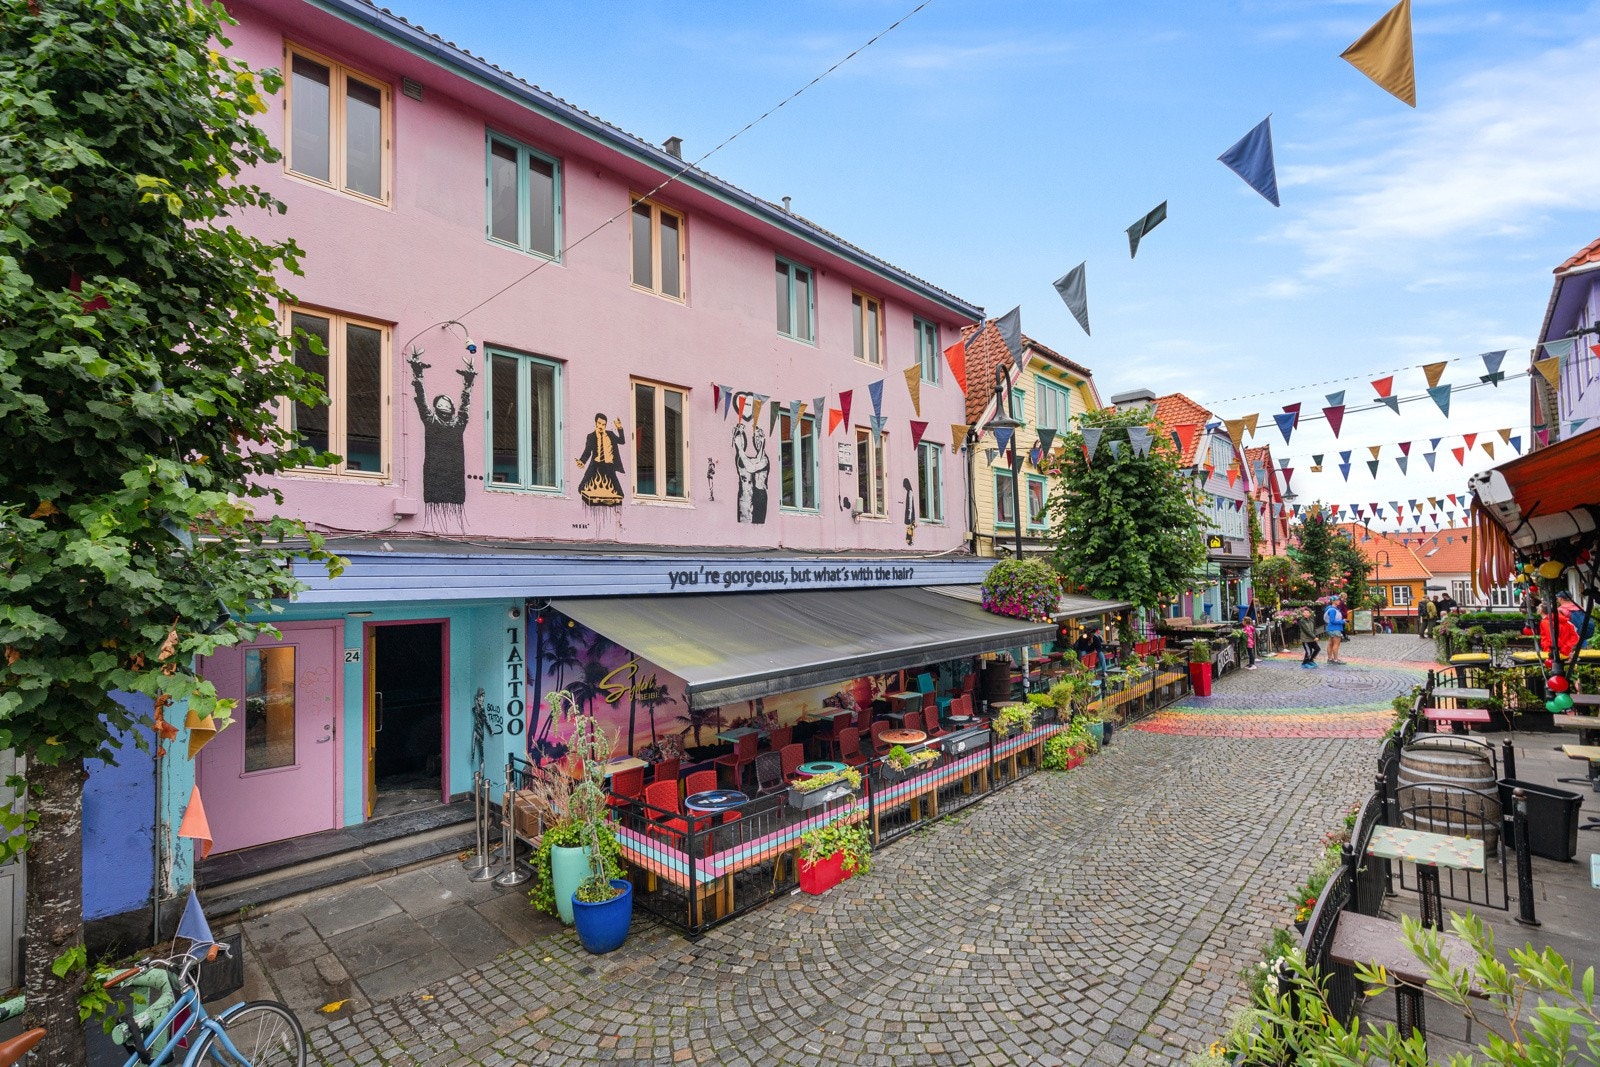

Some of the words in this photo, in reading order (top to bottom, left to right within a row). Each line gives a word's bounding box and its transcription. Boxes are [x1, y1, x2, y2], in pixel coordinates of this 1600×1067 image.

[668, 565, 720, 590] you're
[723, 570, 788, 588] gorgeous,
[790, 567, 811, 583] but
[813, 567, 849, 582] what's
[851, 567, 873, 581] with
[874, 567, 891, 581] the
[892, 567, 913, 581] hair?
[345, 651, 360, 663] 24
[506, 628, 524, 735] TATTOO
